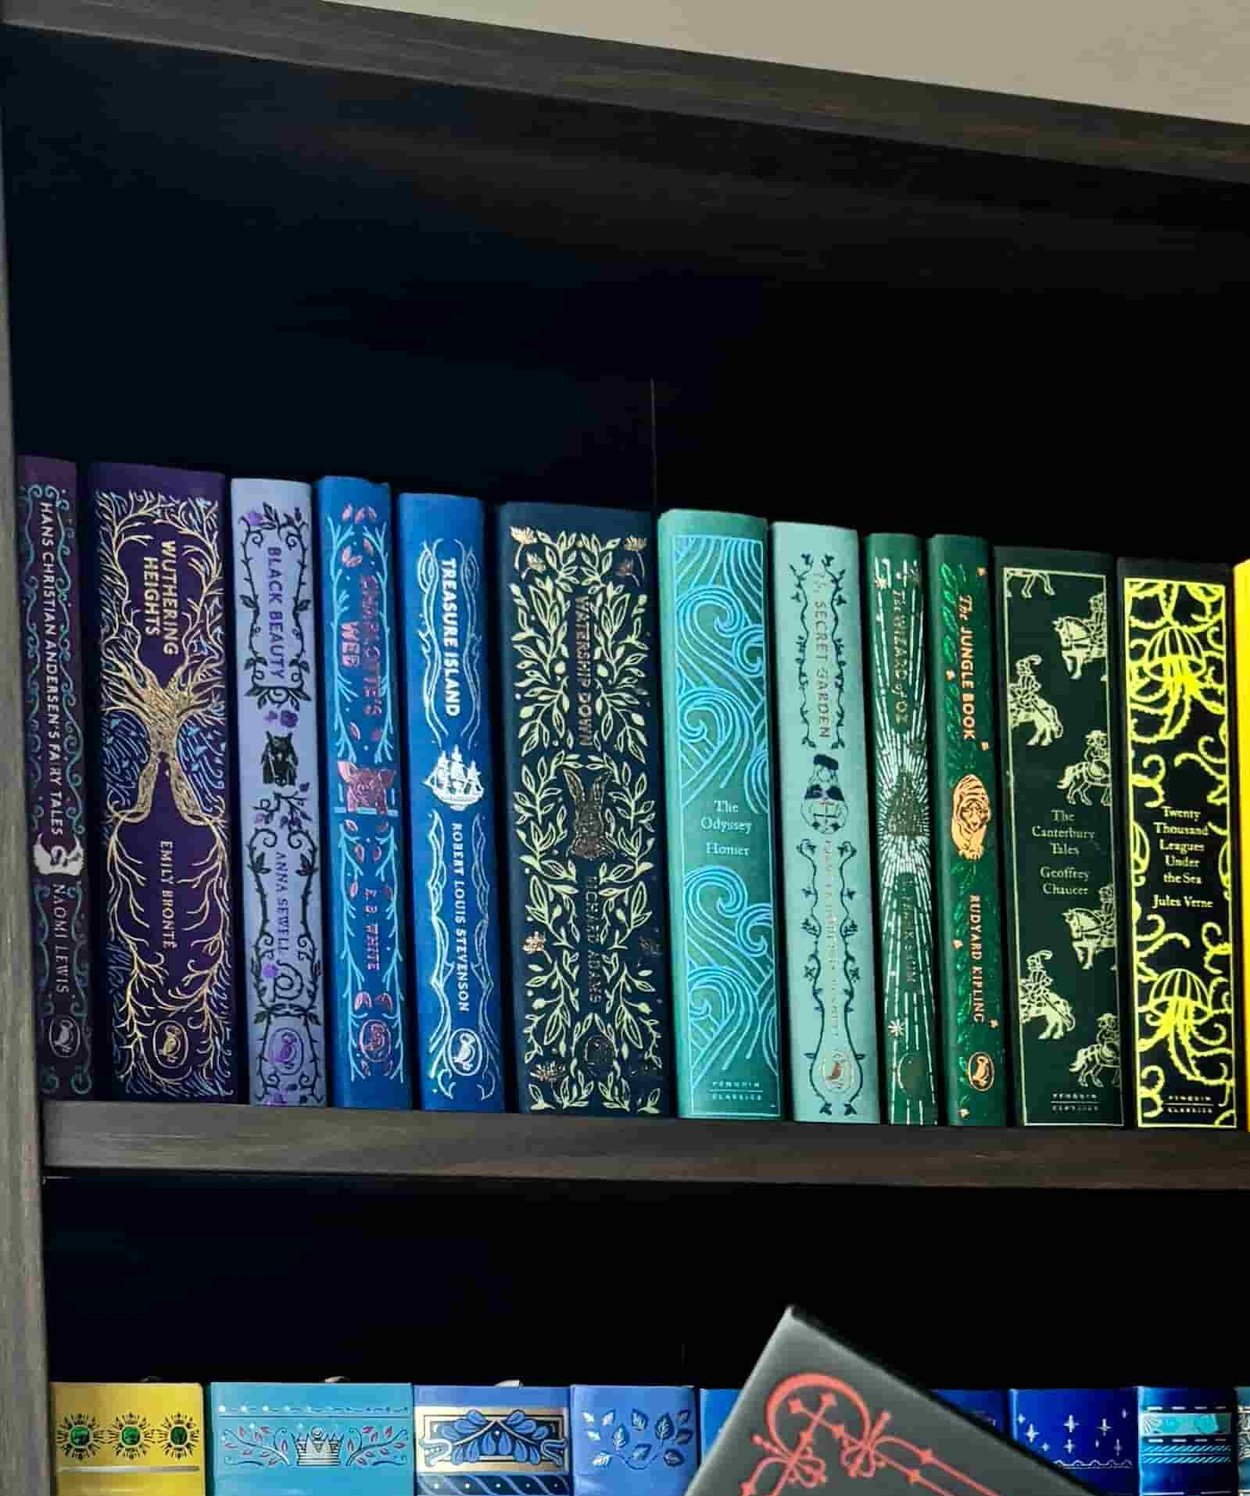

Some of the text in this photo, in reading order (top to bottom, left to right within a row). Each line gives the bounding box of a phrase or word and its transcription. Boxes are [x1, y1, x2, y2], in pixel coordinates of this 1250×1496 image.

[143, 557, 160, 636] HEIGHTS
[161, 540, 179, 656] WUTHERING
[267, 547, 285, 679] BLACK BEAUTY
[341, 621, 360, 667] WEB
[441, 556, 461, 717] TREASURE ISLAND
[814, 601, 829, 660] SECRET
[40, 502, 64, 836] HANS CHRISTIAN ANDERSEN'S FAIRY TALES
[575, 595, 593, 746] WATERSHIP DOWN
[958, 594, 976, 740] The JUNGLE BOOK
[816, 669, 830, 738] GARDEN
[700, 817, 752, 835] Odyssey
[713, 800, 739, 813] The
[1051, 809, 1075, 822] The
[1153, 822, 1209, 836] Thousand
[1160, 806, 1201, 822] Twenty
[706, 841, 750, 856] Homer
[1031, 825, 1095, 840] Canterbury
[1050, 842, 1079, 855] Tales
[1159, 839, 1205, 853] Leagues
[160, 840, 175, 885] EMILY
[1039, 866, 1090, 882] Geoffrey
[1163, 872, 1202, 884] the Sea
[1164, 855, 1200, 868] Under
[276, 852, 289, 950] ANNA SEWELL
[1042, 883, 1089, 896] Chaucer
[1151, 894, 1214, 909] Jules Verne
[53, 883, 69, 994] NAOMI LEWIS
[452, 822, 470, 1012] ROBERT LOUIS STEVENSON
[969, 894, 985, 1023] RUDYARD KIPLING
